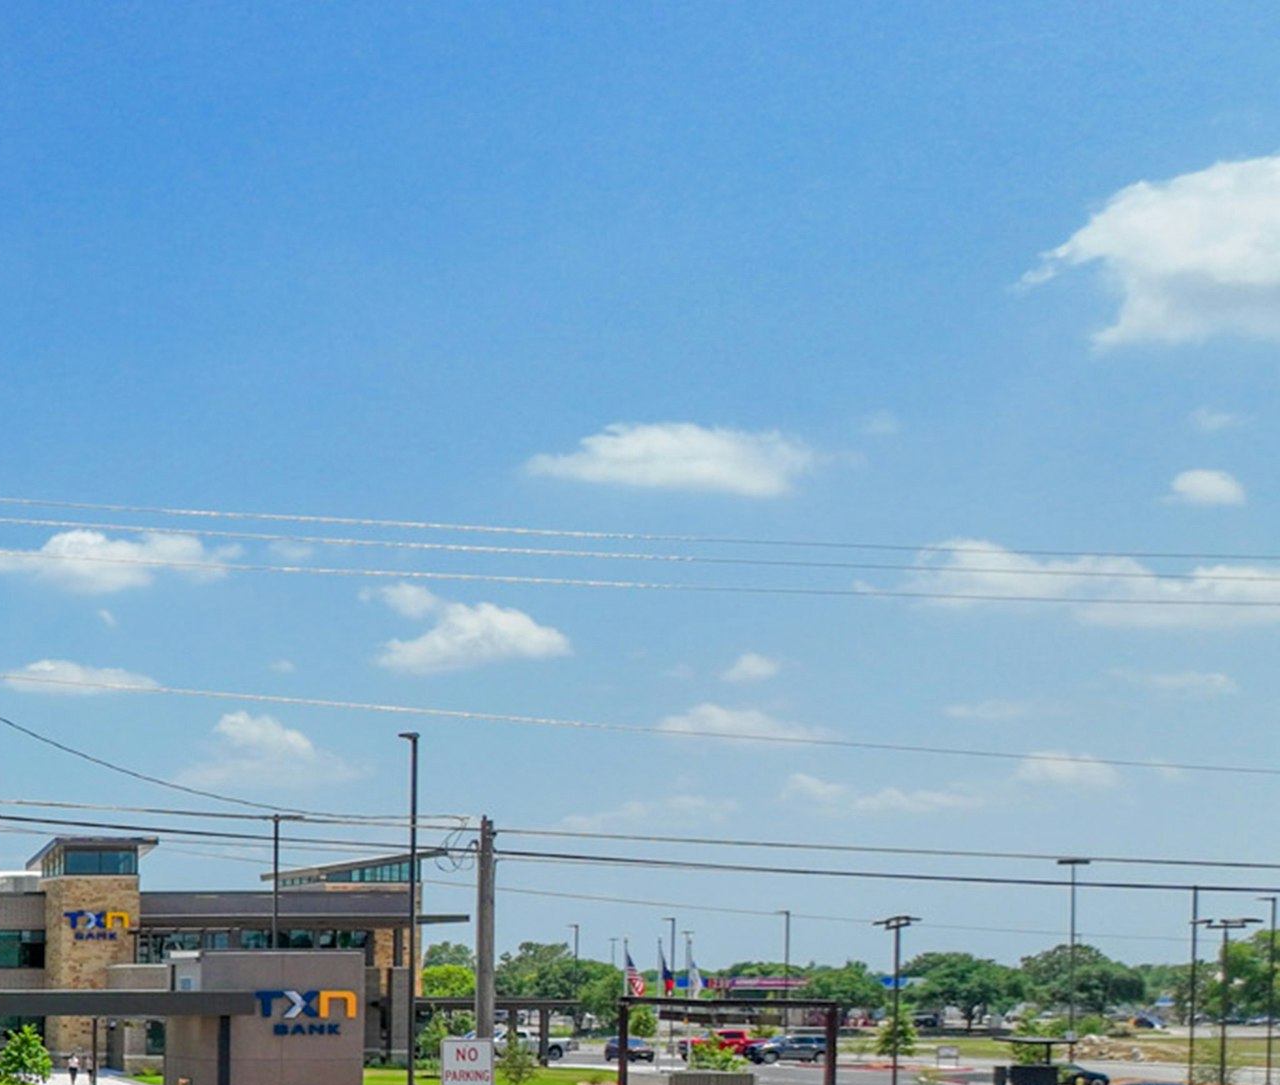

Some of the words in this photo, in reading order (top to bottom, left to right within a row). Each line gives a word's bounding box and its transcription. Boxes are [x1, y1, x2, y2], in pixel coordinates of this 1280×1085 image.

[74, 932, 117, 940] BANK
[273, 1023, 341, 1036] BANK
[455, 1047, 479, 1062] NO
[444, 1069, 491, 1082] PARKING
